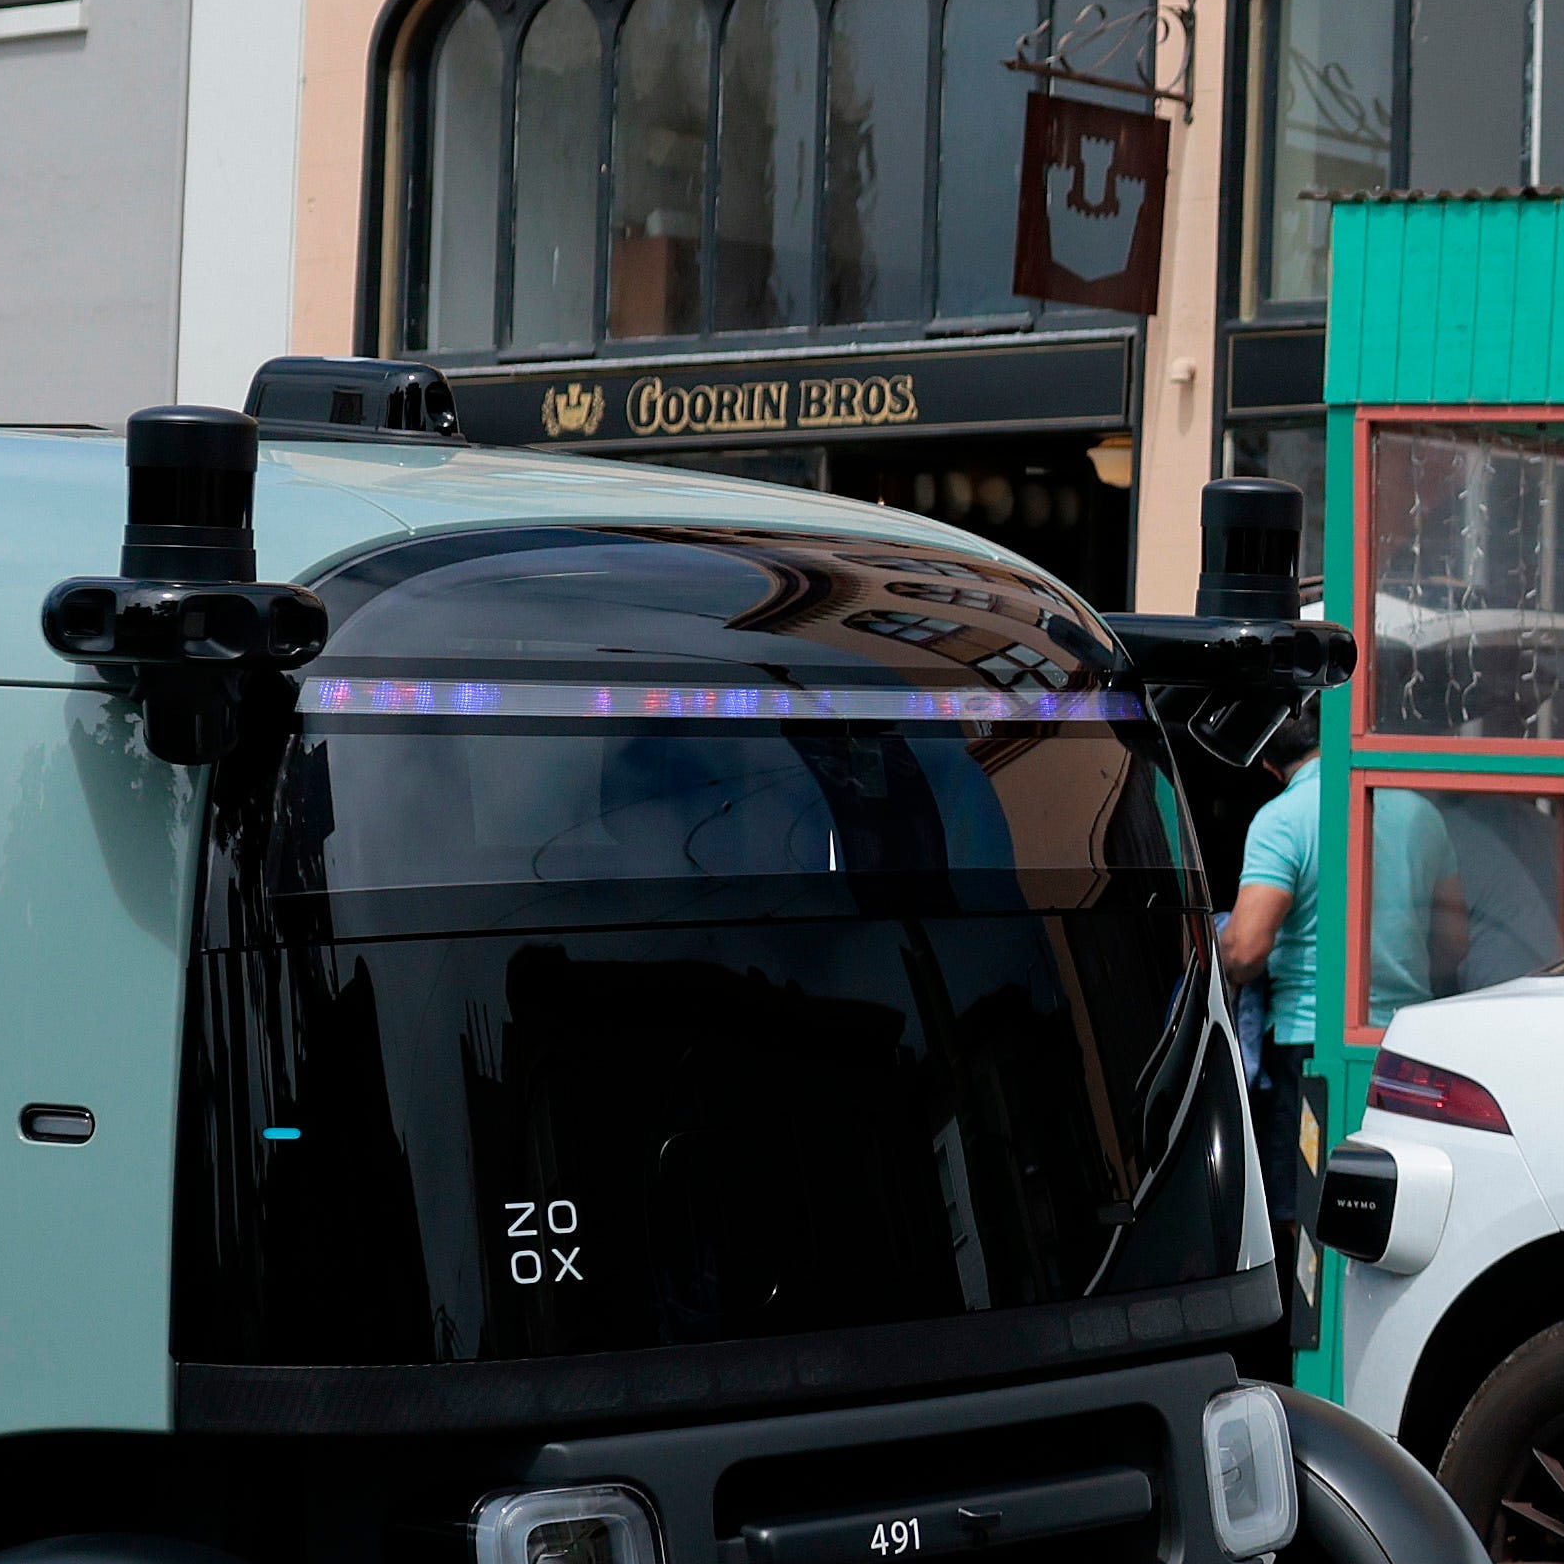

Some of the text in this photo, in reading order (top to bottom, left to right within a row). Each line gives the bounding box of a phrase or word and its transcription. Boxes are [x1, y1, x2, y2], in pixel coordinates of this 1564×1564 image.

[627, 376, 788, 435] GOORIN
[1337, 1199, 1376, 1210] WAYMO
[870, 1517, 922, 1556] 491
